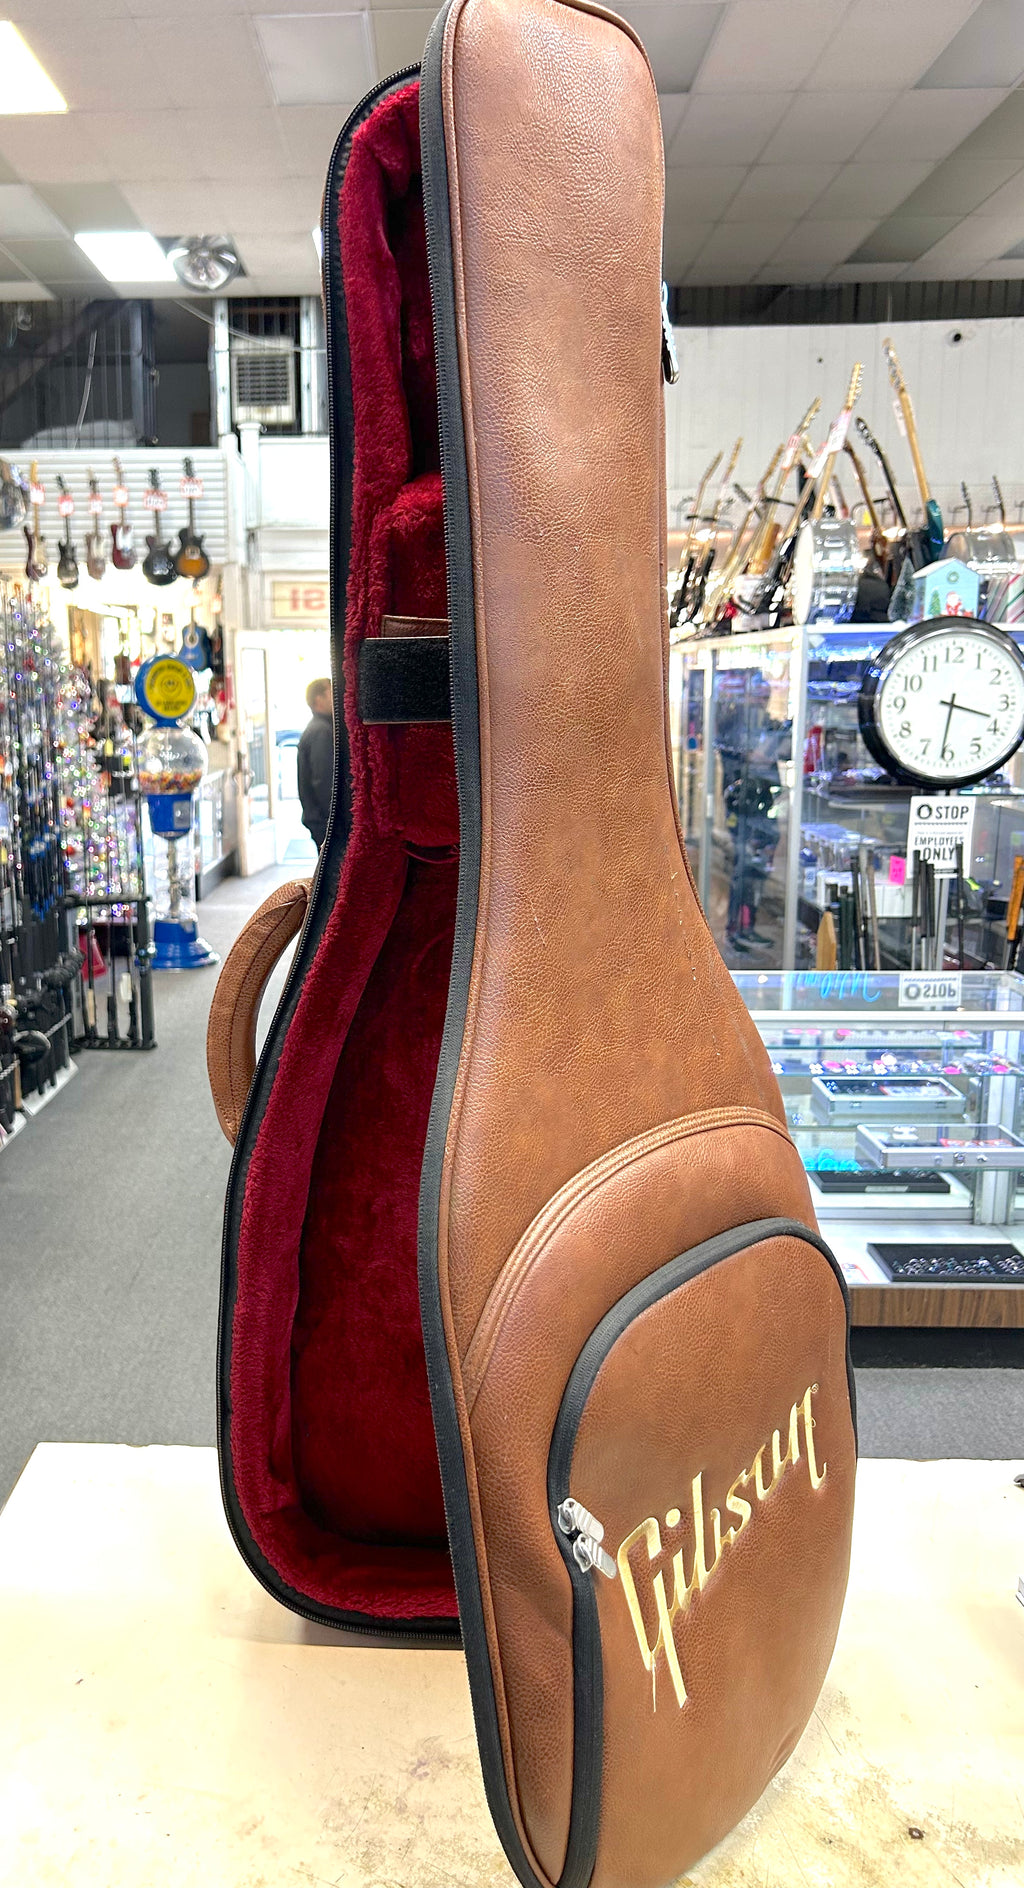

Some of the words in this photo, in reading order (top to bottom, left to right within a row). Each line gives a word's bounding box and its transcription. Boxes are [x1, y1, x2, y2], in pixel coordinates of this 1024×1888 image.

[922, 655, 938, 673] 11
[944, 646, 965, 664] 12
[976, 652, 982, 670] 1
[903, 674, 922, 692] 10
[989, 668, 1001, 685] 2
[893, 695, 906, 714] 9
[998, 693, 1010, 712] 3
[899, 720, 912, 738] 8
[986, 718, 1000, 735] 4
[919, 738, 931, 755] 7
[941, 742, 955, 762] 6
[970, 736, 982, 755] 5
[935, 805, 970, 820] STOP
[914, 835, 964, 847] EMPLOYEES
[922, 847, 956, 861] ONLY
[617, 1384, 828, 1713] Gibson
